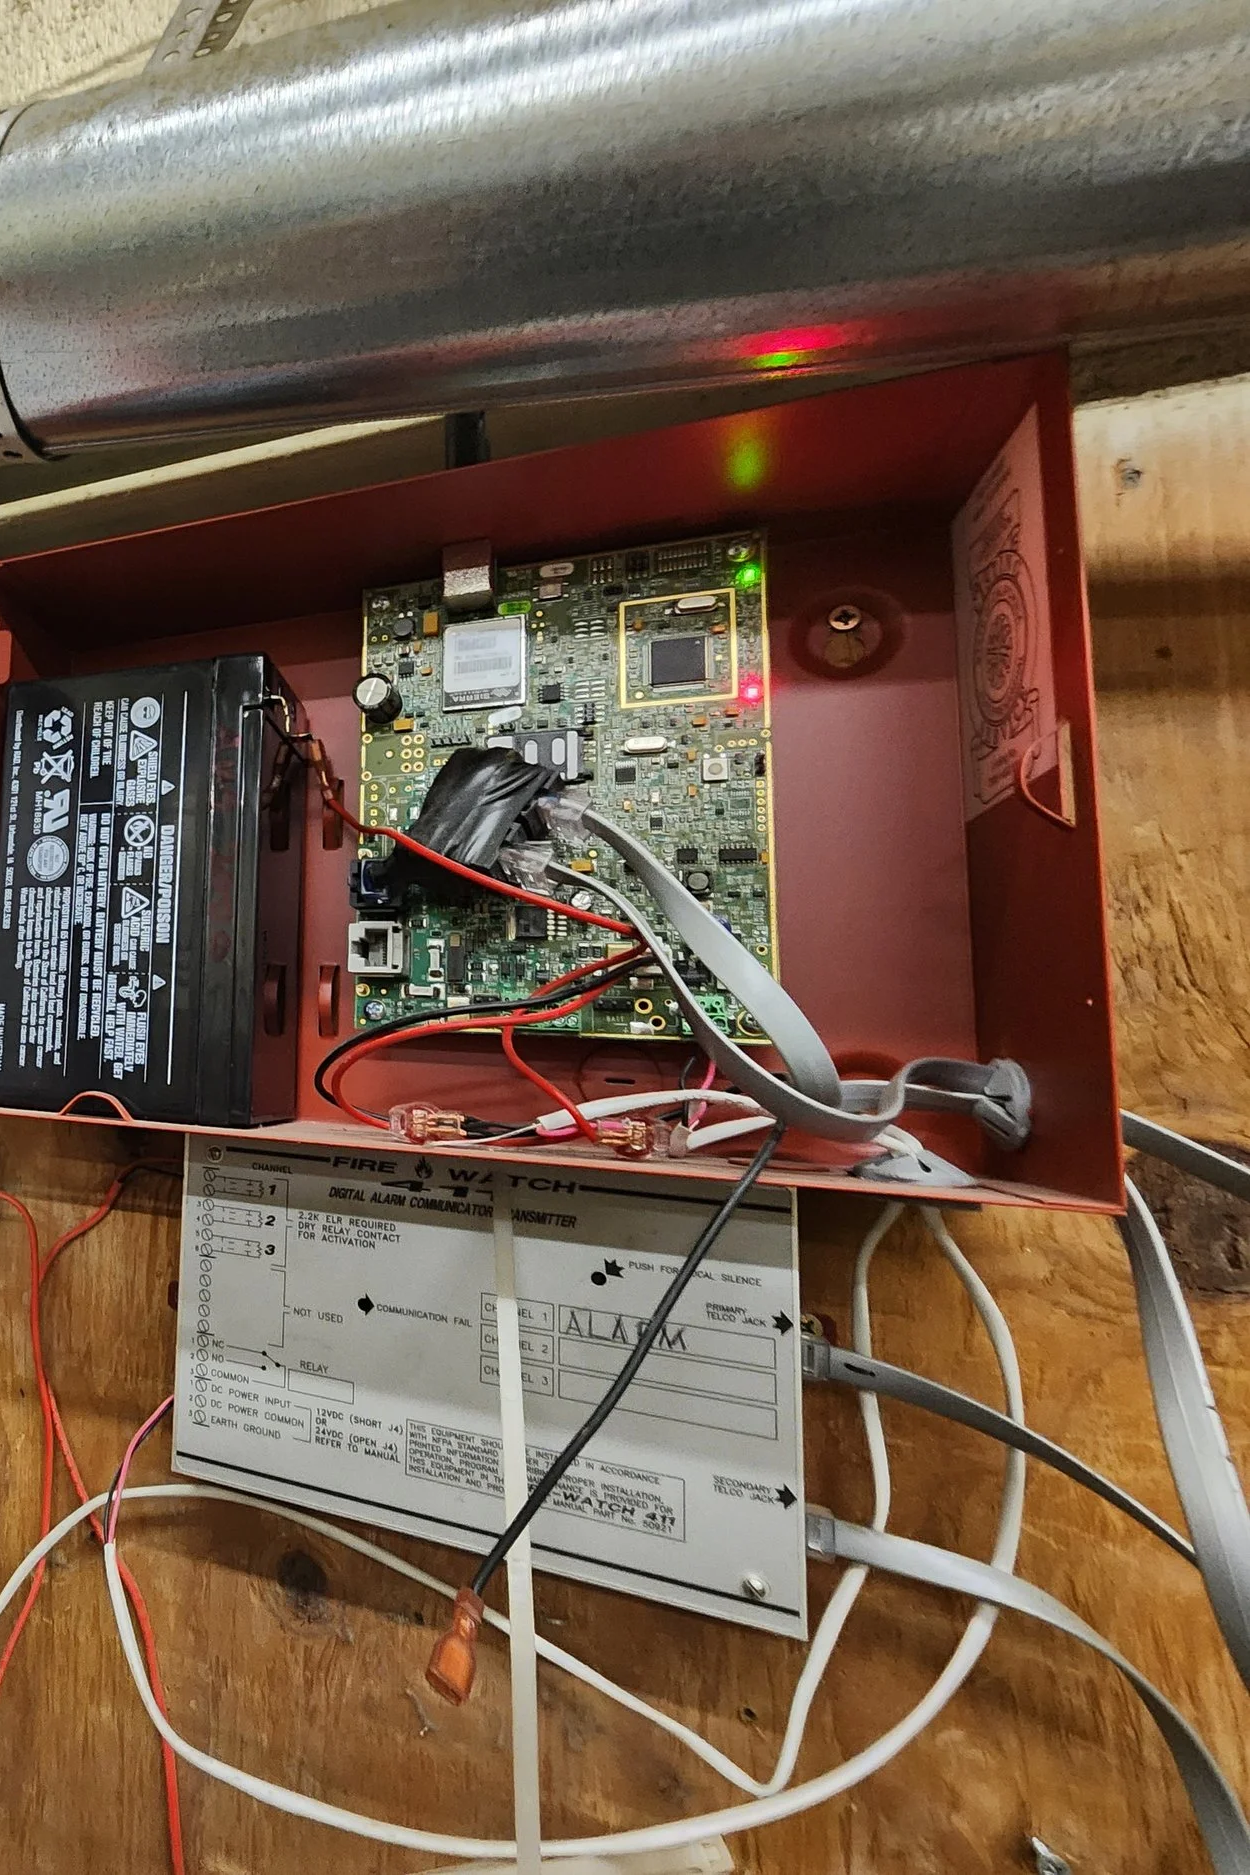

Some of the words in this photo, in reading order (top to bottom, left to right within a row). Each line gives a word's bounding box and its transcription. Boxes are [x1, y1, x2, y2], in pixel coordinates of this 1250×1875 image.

[33, 762, 40, 774] Pb
[156, 825, 175, 943] DANGER/POISON
[252, 1163, 293, 1174] CHANNEL
[332, 1157, 398, 1173] FIRE
[269, 1185, 276, 1196] 1
[328, 1186, 365, 1201] DIGITAL
[370, 1192, 407, 1206] ALARM
[410, 1196, 494, 1217] COMMUNICATOR
[510, 1209, 577, 1228] ANSMITTER
[265, 1215, 276, 1227] 2
[299, 1212, 319, 1221] 2.2K
[326, 1215, 342, 1224] ELR
[349, 1218, 396, 1232] REQUIRED
[298, 1231, 315, 1240] FOR
[321, 1233, 376, 1249] ACTIVATION
[299, 1222, 315, 1231] DRY
[322, 1224, 350, 1235] RELAY
[357, 1230, 400, 1243] CONTACT
[265, 1244, 276, 1255] 3
[628, 1261, 654, 1272] PUSH
[660, 1264, 680, 1275] FOR
[690, 1268, 716, 1281] OCAL
[721, 1273, 763, 1287] SILENCE
[293, 1307, 312, 1317] NOT
[318, 1312, 343, 1323] USED
[376, 1303, 448, 1324] COMMUNICATION
[453, 1317, 472, 1328] FAIL
[212, 1340, 225, 1348] NC
[212, 1354, 224, 1363] NO
[300, 1360, 329, 1374] RELAY
[211, 1369, 249, 1384] COMMON
[211, 1384, 223, 1394] DC
[229, 1388, 259, 1402] POWER
[264, 1396, 291, 1408] INPUT
[317, 1408, 344, 1420] 12VDC
[350, 1414, 382, 1429] (SHORT
[389, 1423, 404, 1435] J4)
